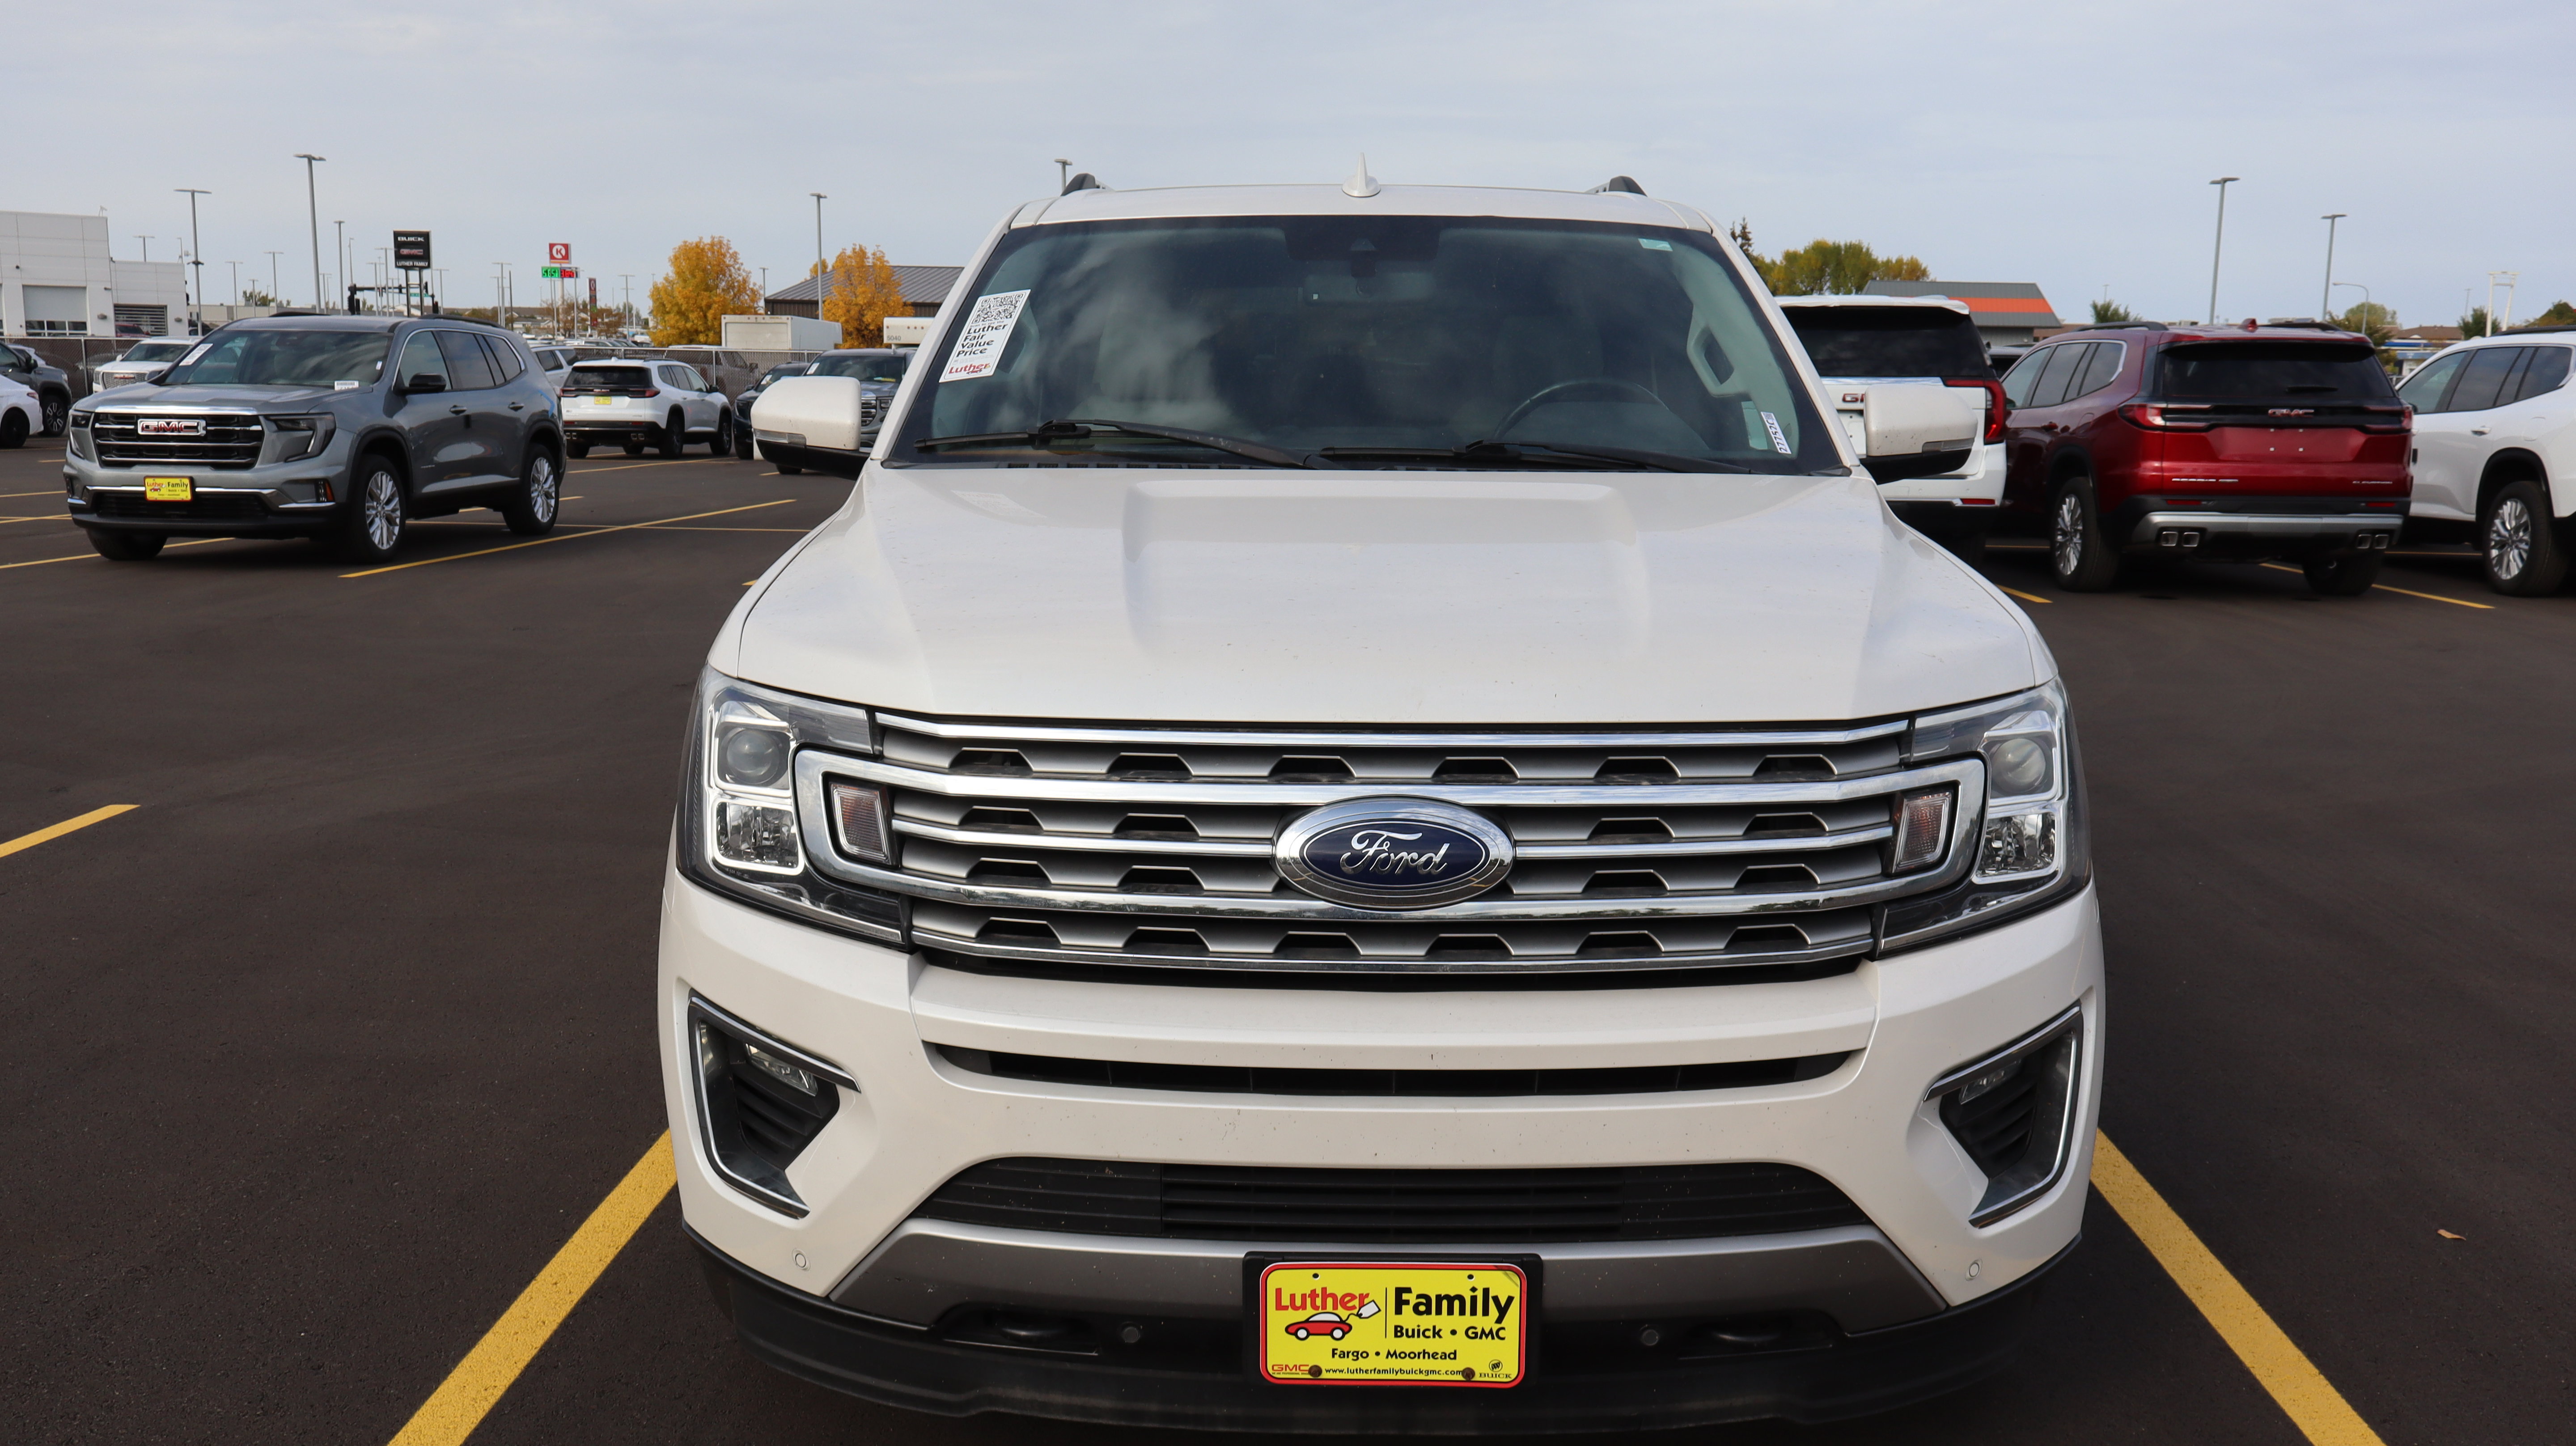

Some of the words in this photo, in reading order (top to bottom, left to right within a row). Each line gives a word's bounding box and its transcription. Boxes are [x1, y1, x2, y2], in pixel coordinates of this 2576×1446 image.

[967, 324, 1008, 335] Luther
[963, 333, 987, 342] Fair
[961, 340, 994, 349] Value
[956, 348, 987, 357] Price
[949, 363, 990, 374] Luther
[141, 421, 198, 432] GMC
[1766, 420, 1788, 453] 27752C
[1340, 830, 1450, 874] Ford
[1275, 1287, 1370, 1311] Luther
[1394, 1286, 1515, 1324] Family
[1394, 1324, 1443, 1339] Buick
[1465, 1326, 1506, 1340] GMC
[1331, 1348, 1369, 1361] Fargo
[1385, 1349, 1457, 1360] Moorhead
[1325, 1367, 1462, 1376] www.lutherfamilybuickgmc.com
